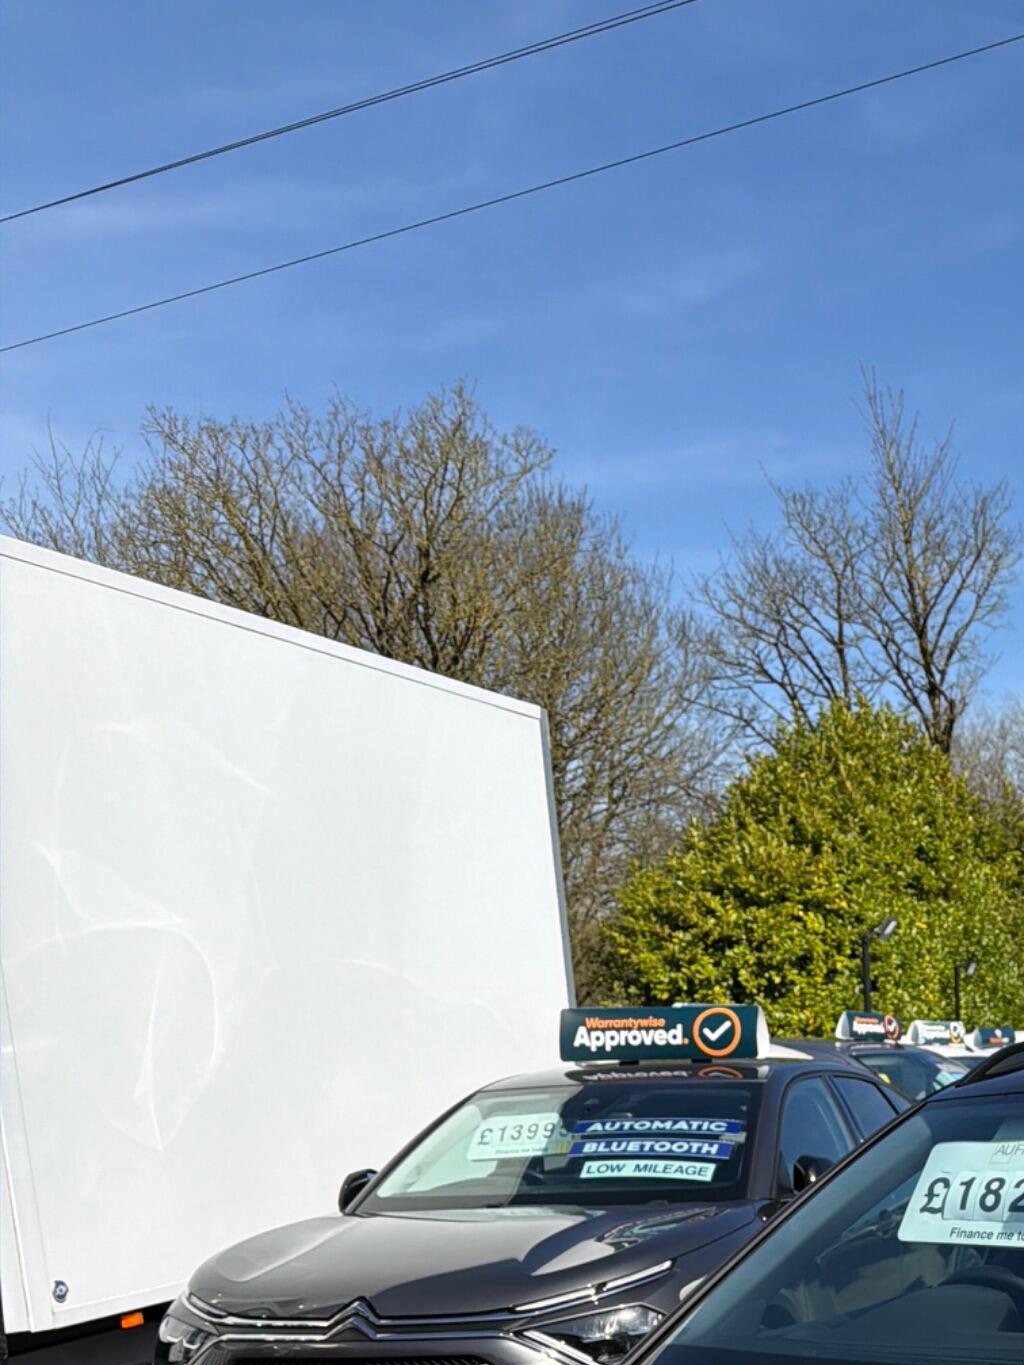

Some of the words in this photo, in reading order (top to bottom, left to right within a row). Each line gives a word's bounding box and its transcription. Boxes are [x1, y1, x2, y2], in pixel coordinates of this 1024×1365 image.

[585, 1016, 666, 1029] Warrantywise
[573, 1023, 689, 1052] Approved.
[586, 1120, 728, 1132] AUTOMATIC
[582, 1141, 719, 1154] BLUETOOTH
[586, 1163, 626, 1174] LOW
[633, 1163, 709, 1177] MILEAGE
[949, 1227, 995, 1240] Finance
[996, 1231, 1014, 1241] me
